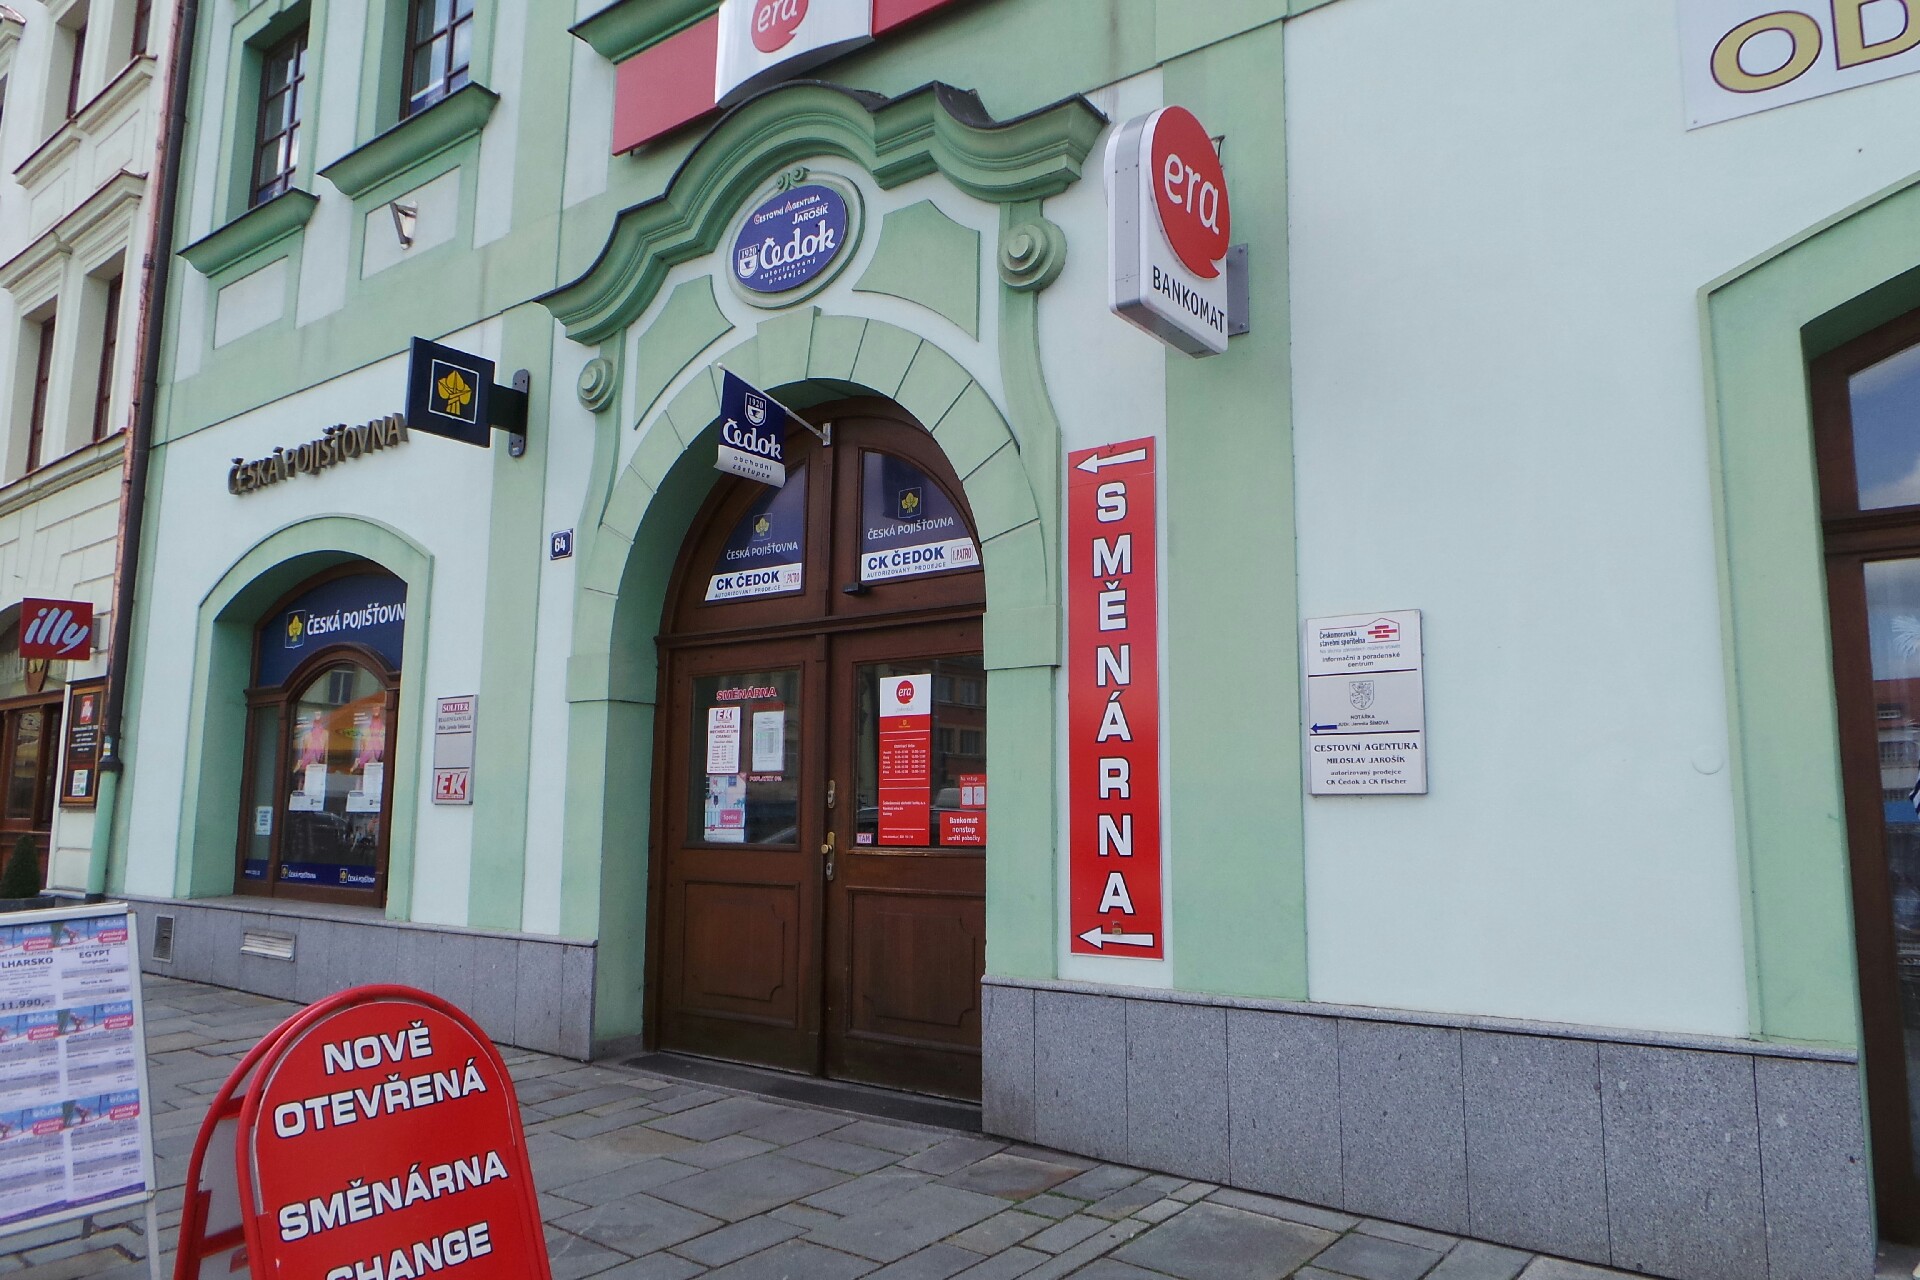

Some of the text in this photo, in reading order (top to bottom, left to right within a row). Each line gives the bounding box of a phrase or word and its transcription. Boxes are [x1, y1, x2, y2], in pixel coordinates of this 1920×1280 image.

[757, 0, 798, 33] era
[1164, 153, 1220, 235] era
[741, 246, 757, 259] 1920
[760, 219, 836, 270] Čedok
[1153, 265, 1225, 333] BANKOMAT
[748, 396, 764, 410] 1920
[722, 417, 783, 460] Čedok
[228, 412, 409, 495] ČESKÁ POJIŠŤOVNA
[867, 516, 955, 540] ČESKÁ POJIŠŤOVNA
[554, 537, 566, 553] 64
[726, 541, 798, 560] ČESKÁ POJIŠŤOVNA
[867, 545, 945, 571] CK ČEDOK
[716, 570, 780, 591] CK ČEDOK
[24, 607, 90, 655] illy
[307, 609, 341, 636] ČESKÁ
[1319, 629, 1357, 640] Českomoravská
[1363, 652, 1400, 661] poradenské
[716, 686, 777, 701] SMĚNÁRNA
[898, 686, 911, 697] era
[1092, 480, 1134, 916] SMĚNÁRNA
[1314, 742, 1418, 752] CESTOVNÍ AGENTURA
[1369, 754, 1405, 764] JAROŠÍK
[438, 772, 468, 795] EK
[950, 816, 978, 824] Bankomat
[952, 826, 975, 834] nonstop
[79, 949, 110, 959] EGYPT
[323, 1020, 432, 1075] NOVĚ
[273, 1057, 487, 1139] OTEVŘENÁ
[278, 1150, 509, 1242] SMĚNÁRNA
